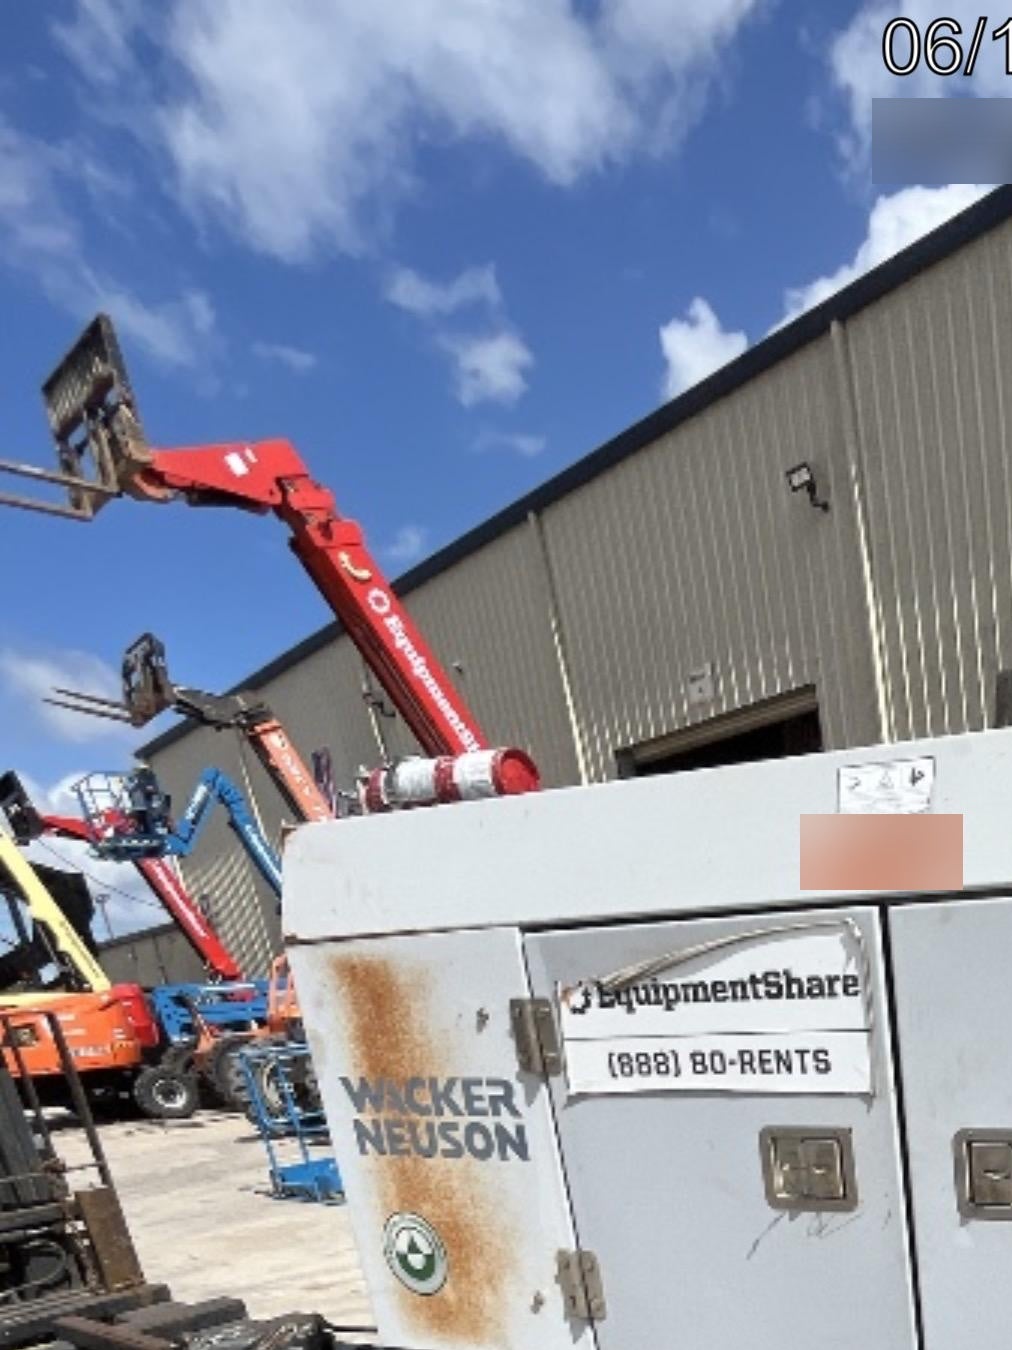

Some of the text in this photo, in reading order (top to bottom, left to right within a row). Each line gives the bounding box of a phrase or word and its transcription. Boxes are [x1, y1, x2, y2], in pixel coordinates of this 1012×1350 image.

[608, 1050, 681, 1078] (888)
[338, 1076, 522, 1118] WACKER
[353, 1119, 530, 1161] NEUSON
